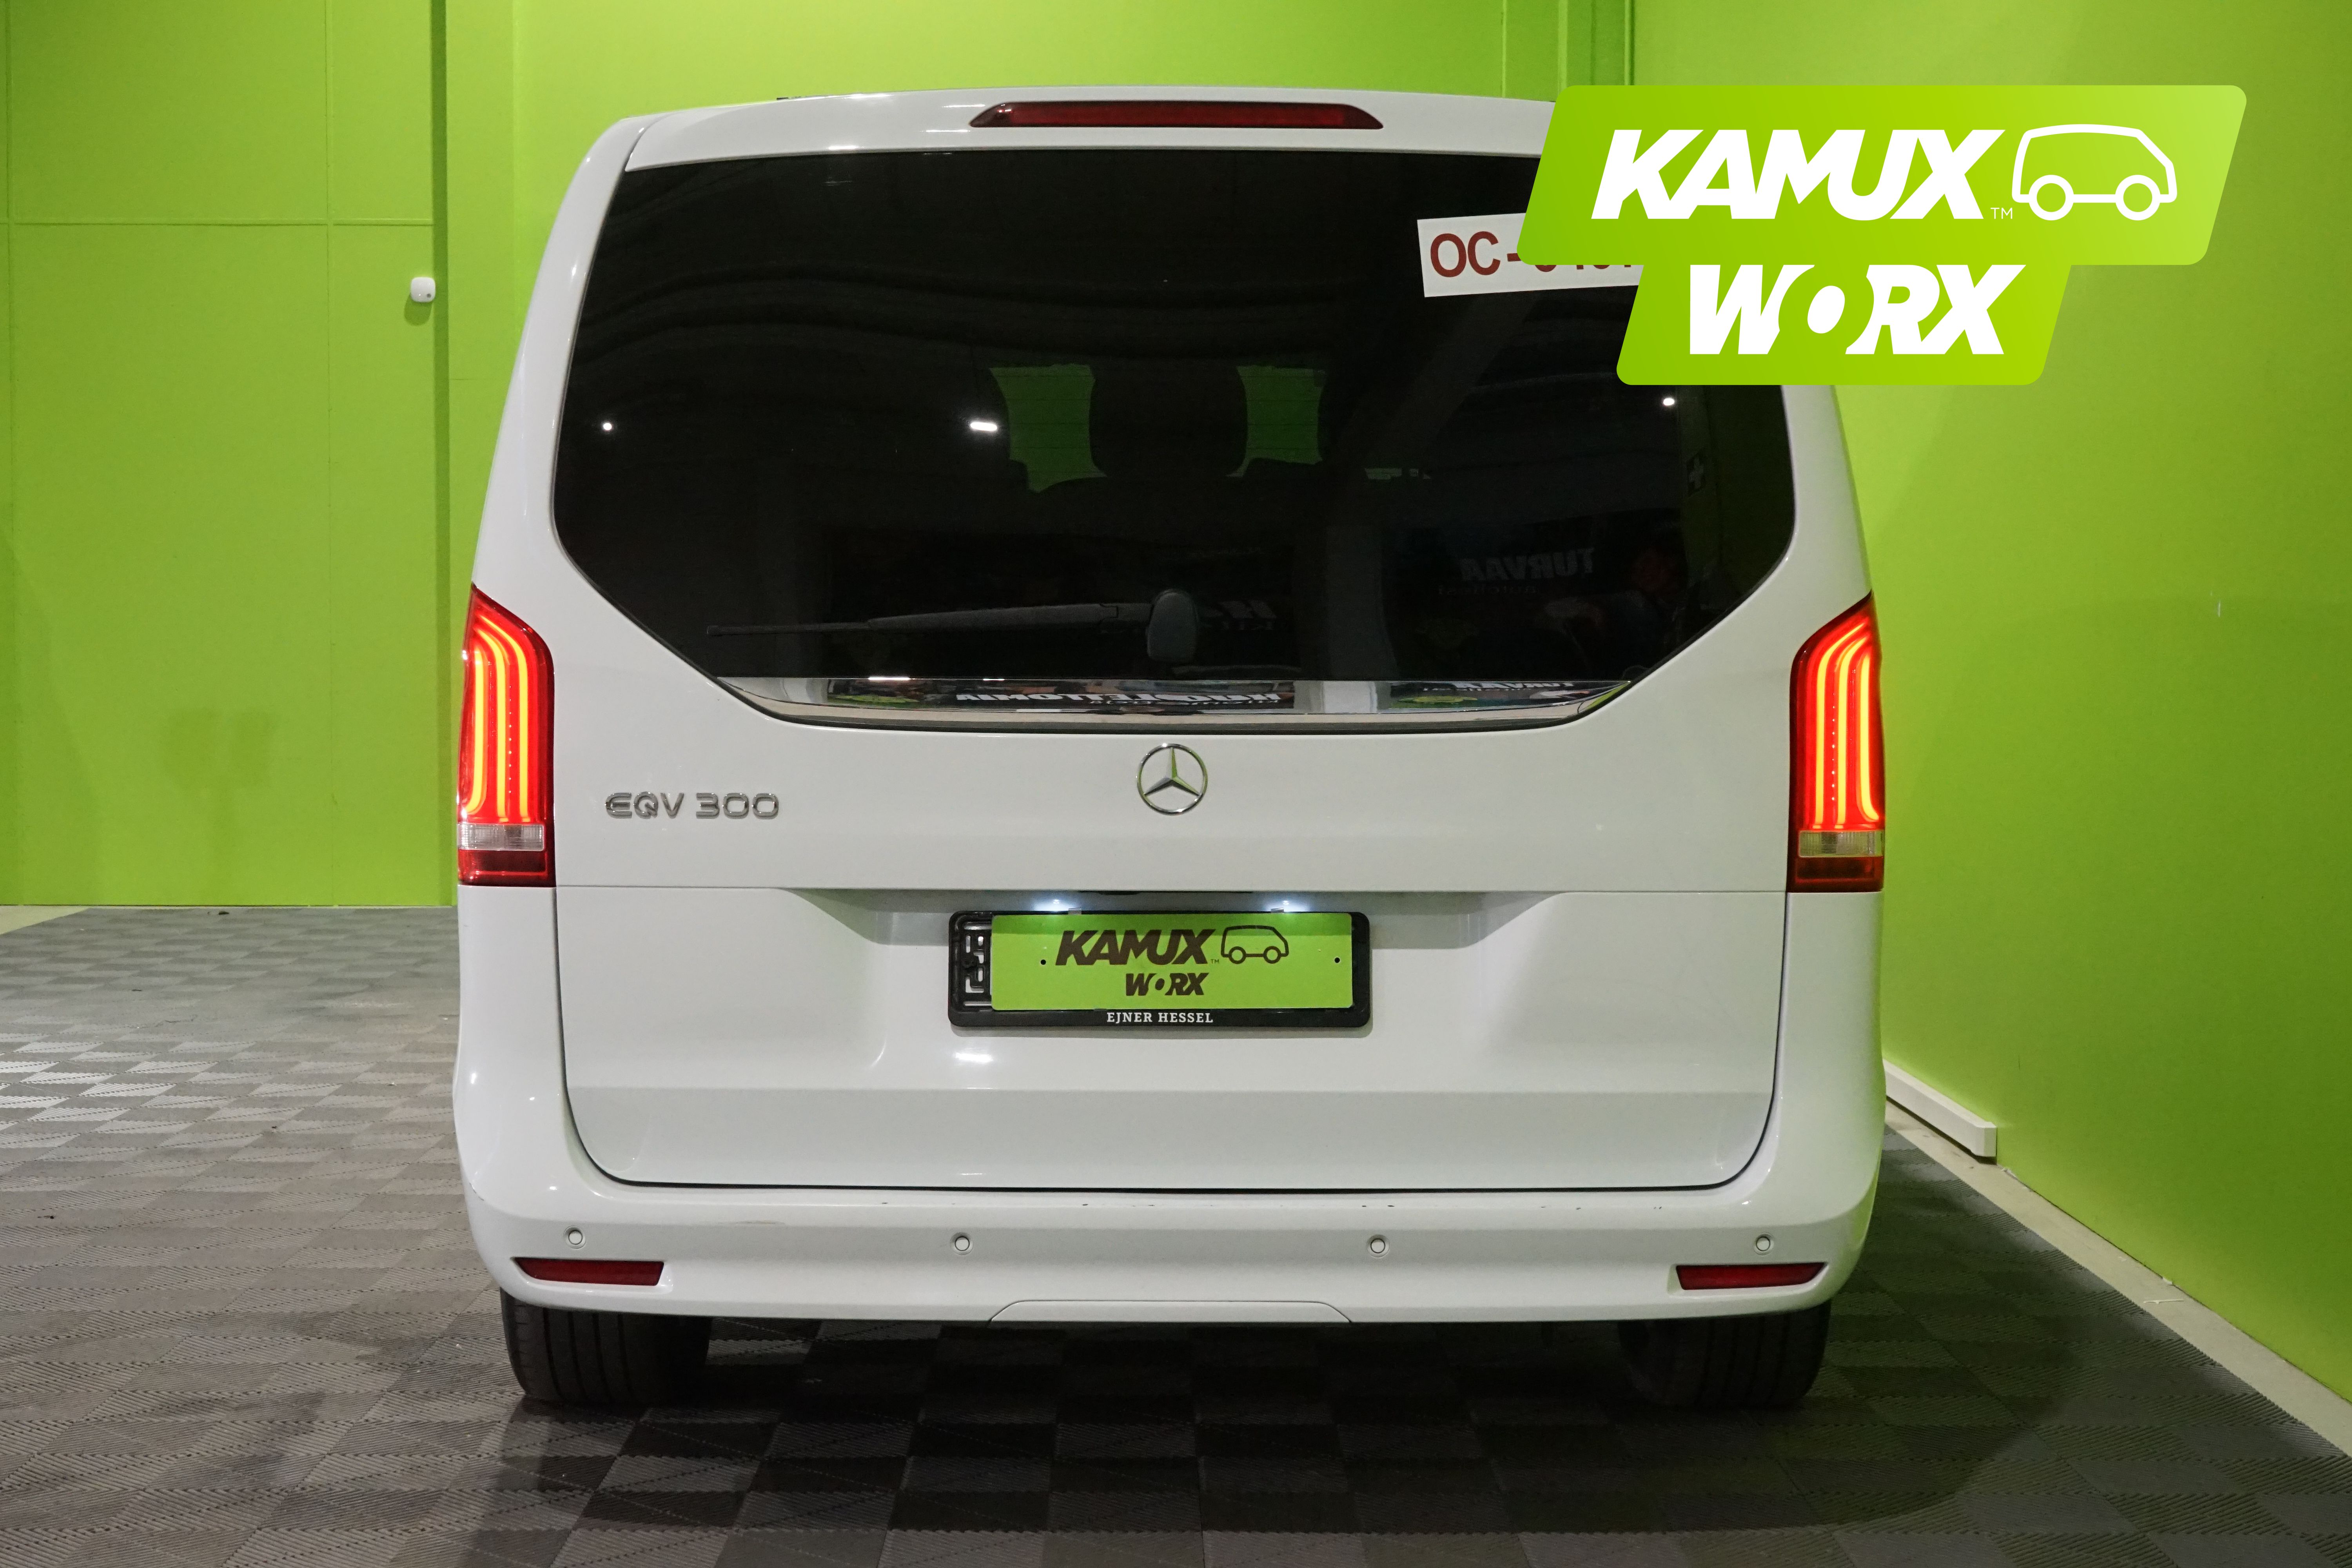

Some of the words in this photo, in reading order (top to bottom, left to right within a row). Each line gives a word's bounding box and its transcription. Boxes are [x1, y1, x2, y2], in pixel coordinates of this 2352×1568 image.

[604, 791, 684, 818] EQV
[696, 793, 779, 819] 300
[1055, 929, 1216, 965] KAMUX
[1125, 973, 1209, 996] WORX
[1107, 1012, 1152, 1024] EJNER
[1158, 1012, 1213, 1023] HESSEL
